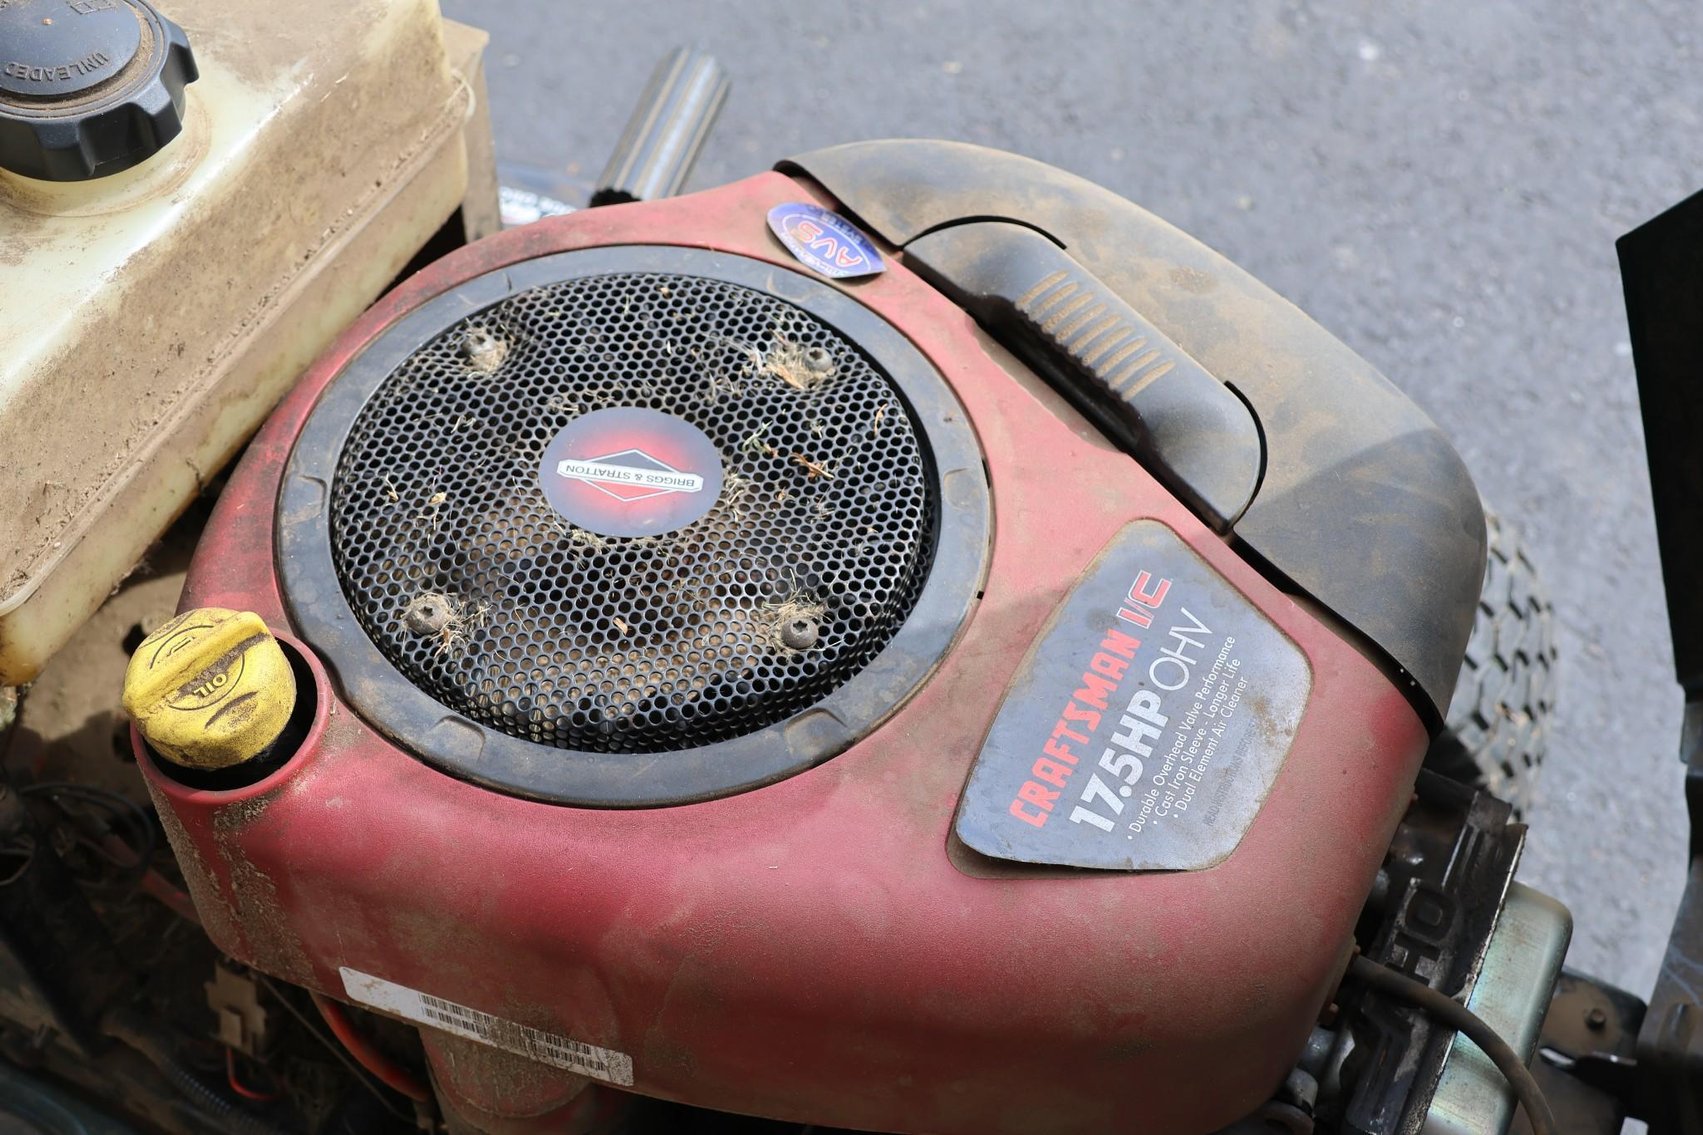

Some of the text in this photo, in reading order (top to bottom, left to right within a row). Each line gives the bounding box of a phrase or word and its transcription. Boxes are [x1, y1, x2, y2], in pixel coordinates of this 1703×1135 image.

[5, 52, 109, 82] UNLEADED
[790, 220, 863, 268] AVS
[565, 464, 695, 487] BRIGGS & STRATTON
[192, 673, 227, 697] OIL
[1009, 628, 1141, 828] CRAFTSMAN
[1069, 607, 1212, 832] 17.5HP OHV
[1129, 635, 1235, 832] Durable Overhead Valve Performance
[1155, 790, 1175, 817] Cast
[1167, 766, 1189, 790] Iron
[1181, 727, 1207, 763] Sleeve
[1203, 679, 1229, 719] Longer
[1226, 658, 1240, 682] Life
[1174, 676, 1248, 811] Dual Element Air Cleaner
